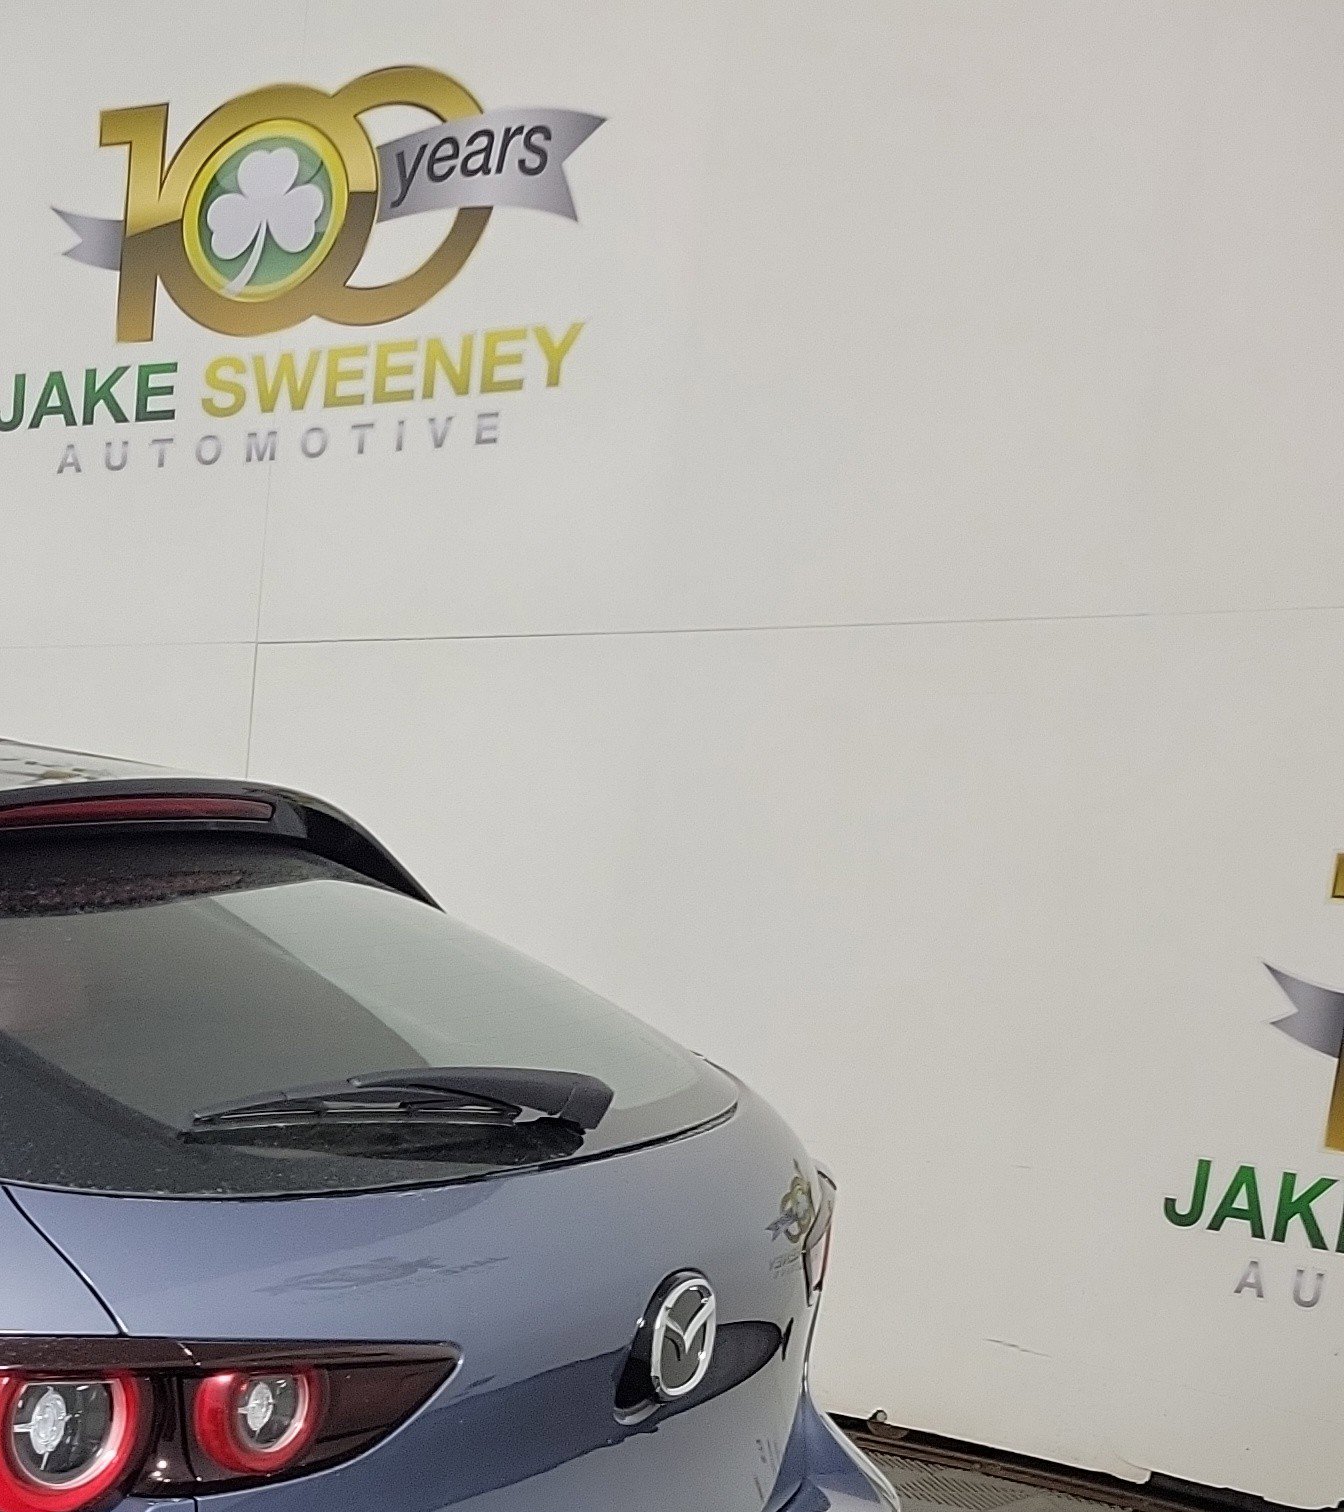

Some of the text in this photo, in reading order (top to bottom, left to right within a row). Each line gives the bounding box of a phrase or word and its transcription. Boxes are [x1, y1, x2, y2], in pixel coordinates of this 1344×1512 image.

[99, 65, 551, 343] 100 years
[199, 321, 586, 418] SWEENEY
[56, 411, 501, 475] AUTOMOTIVE
[1163, 1157, 1344, 1255] JAK
